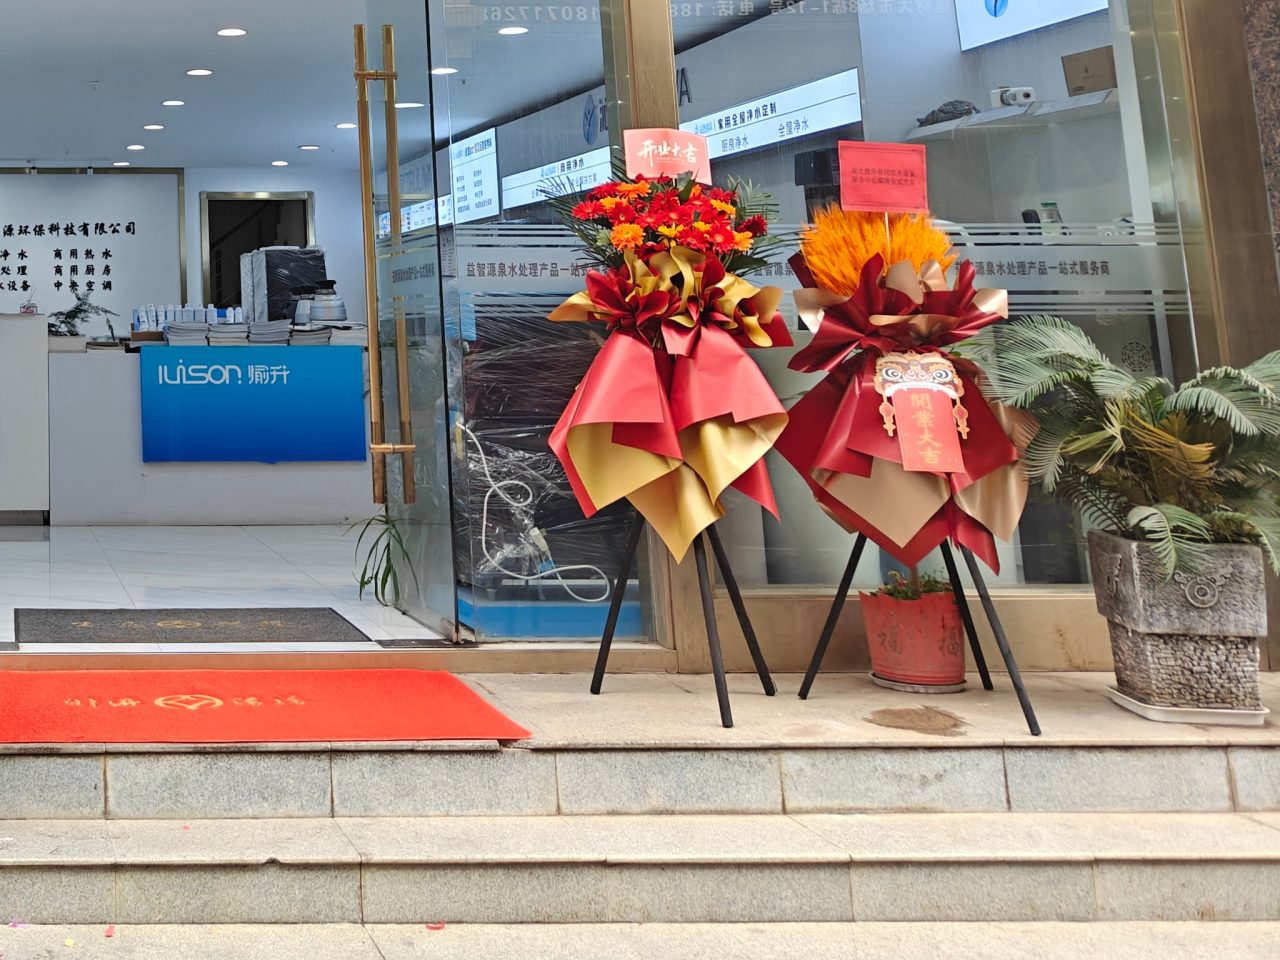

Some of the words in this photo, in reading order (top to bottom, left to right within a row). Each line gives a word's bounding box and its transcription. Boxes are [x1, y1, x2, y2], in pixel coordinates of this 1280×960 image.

[637, 139, 698, 168] 开业大吉
[53, 248, 113, 260] 商用热水
[53, 264, 113, 276] 商用厨房
[954, 261, 1110, 277] 源泉水处理产品一站式服务商
